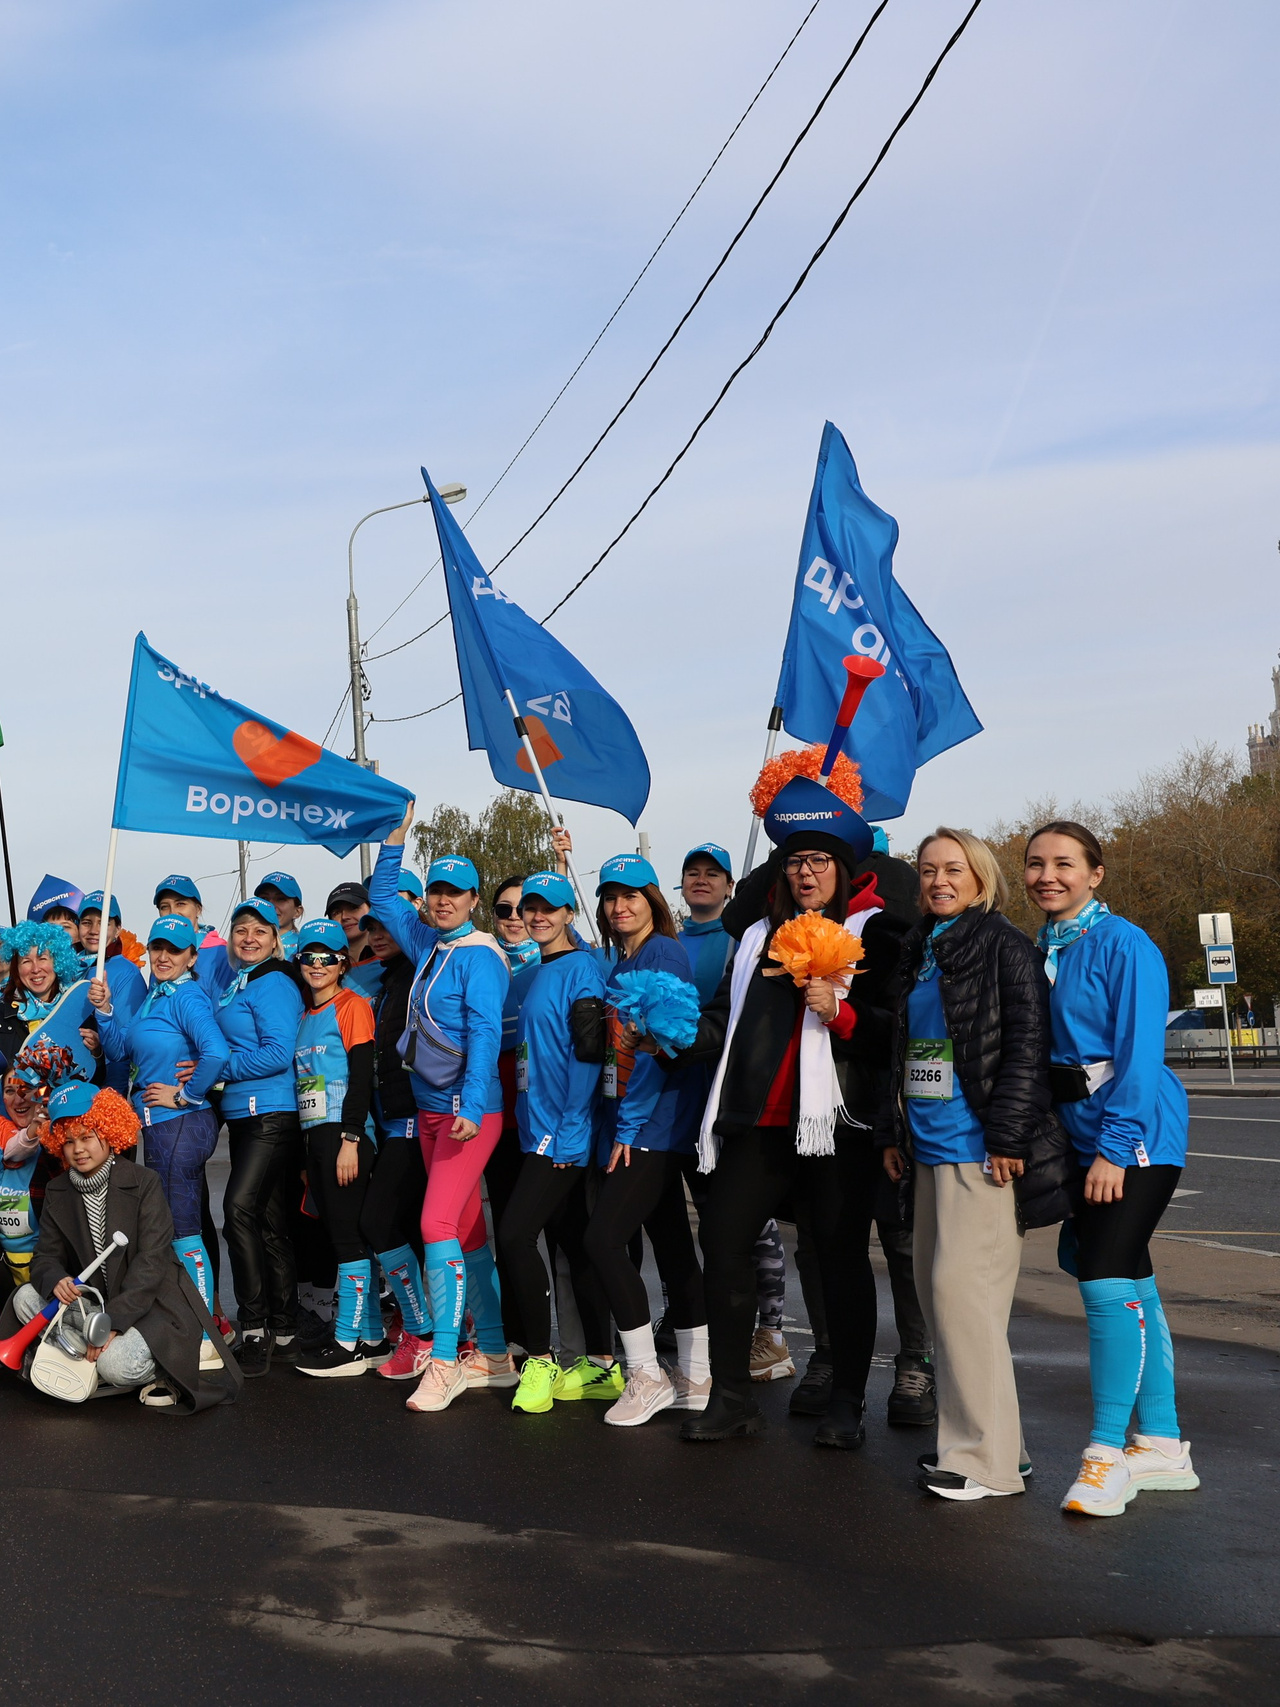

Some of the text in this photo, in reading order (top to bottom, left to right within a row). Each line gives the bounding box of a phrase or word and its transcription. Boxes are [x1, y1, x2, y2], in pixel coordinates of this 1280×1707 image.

[185, 785, 356, 831] Воронеж
[774, 811, 833, 824] здравсити
[32, 892, 69, 912] здравсити
[910, 1069, 942, 1083] 52266
